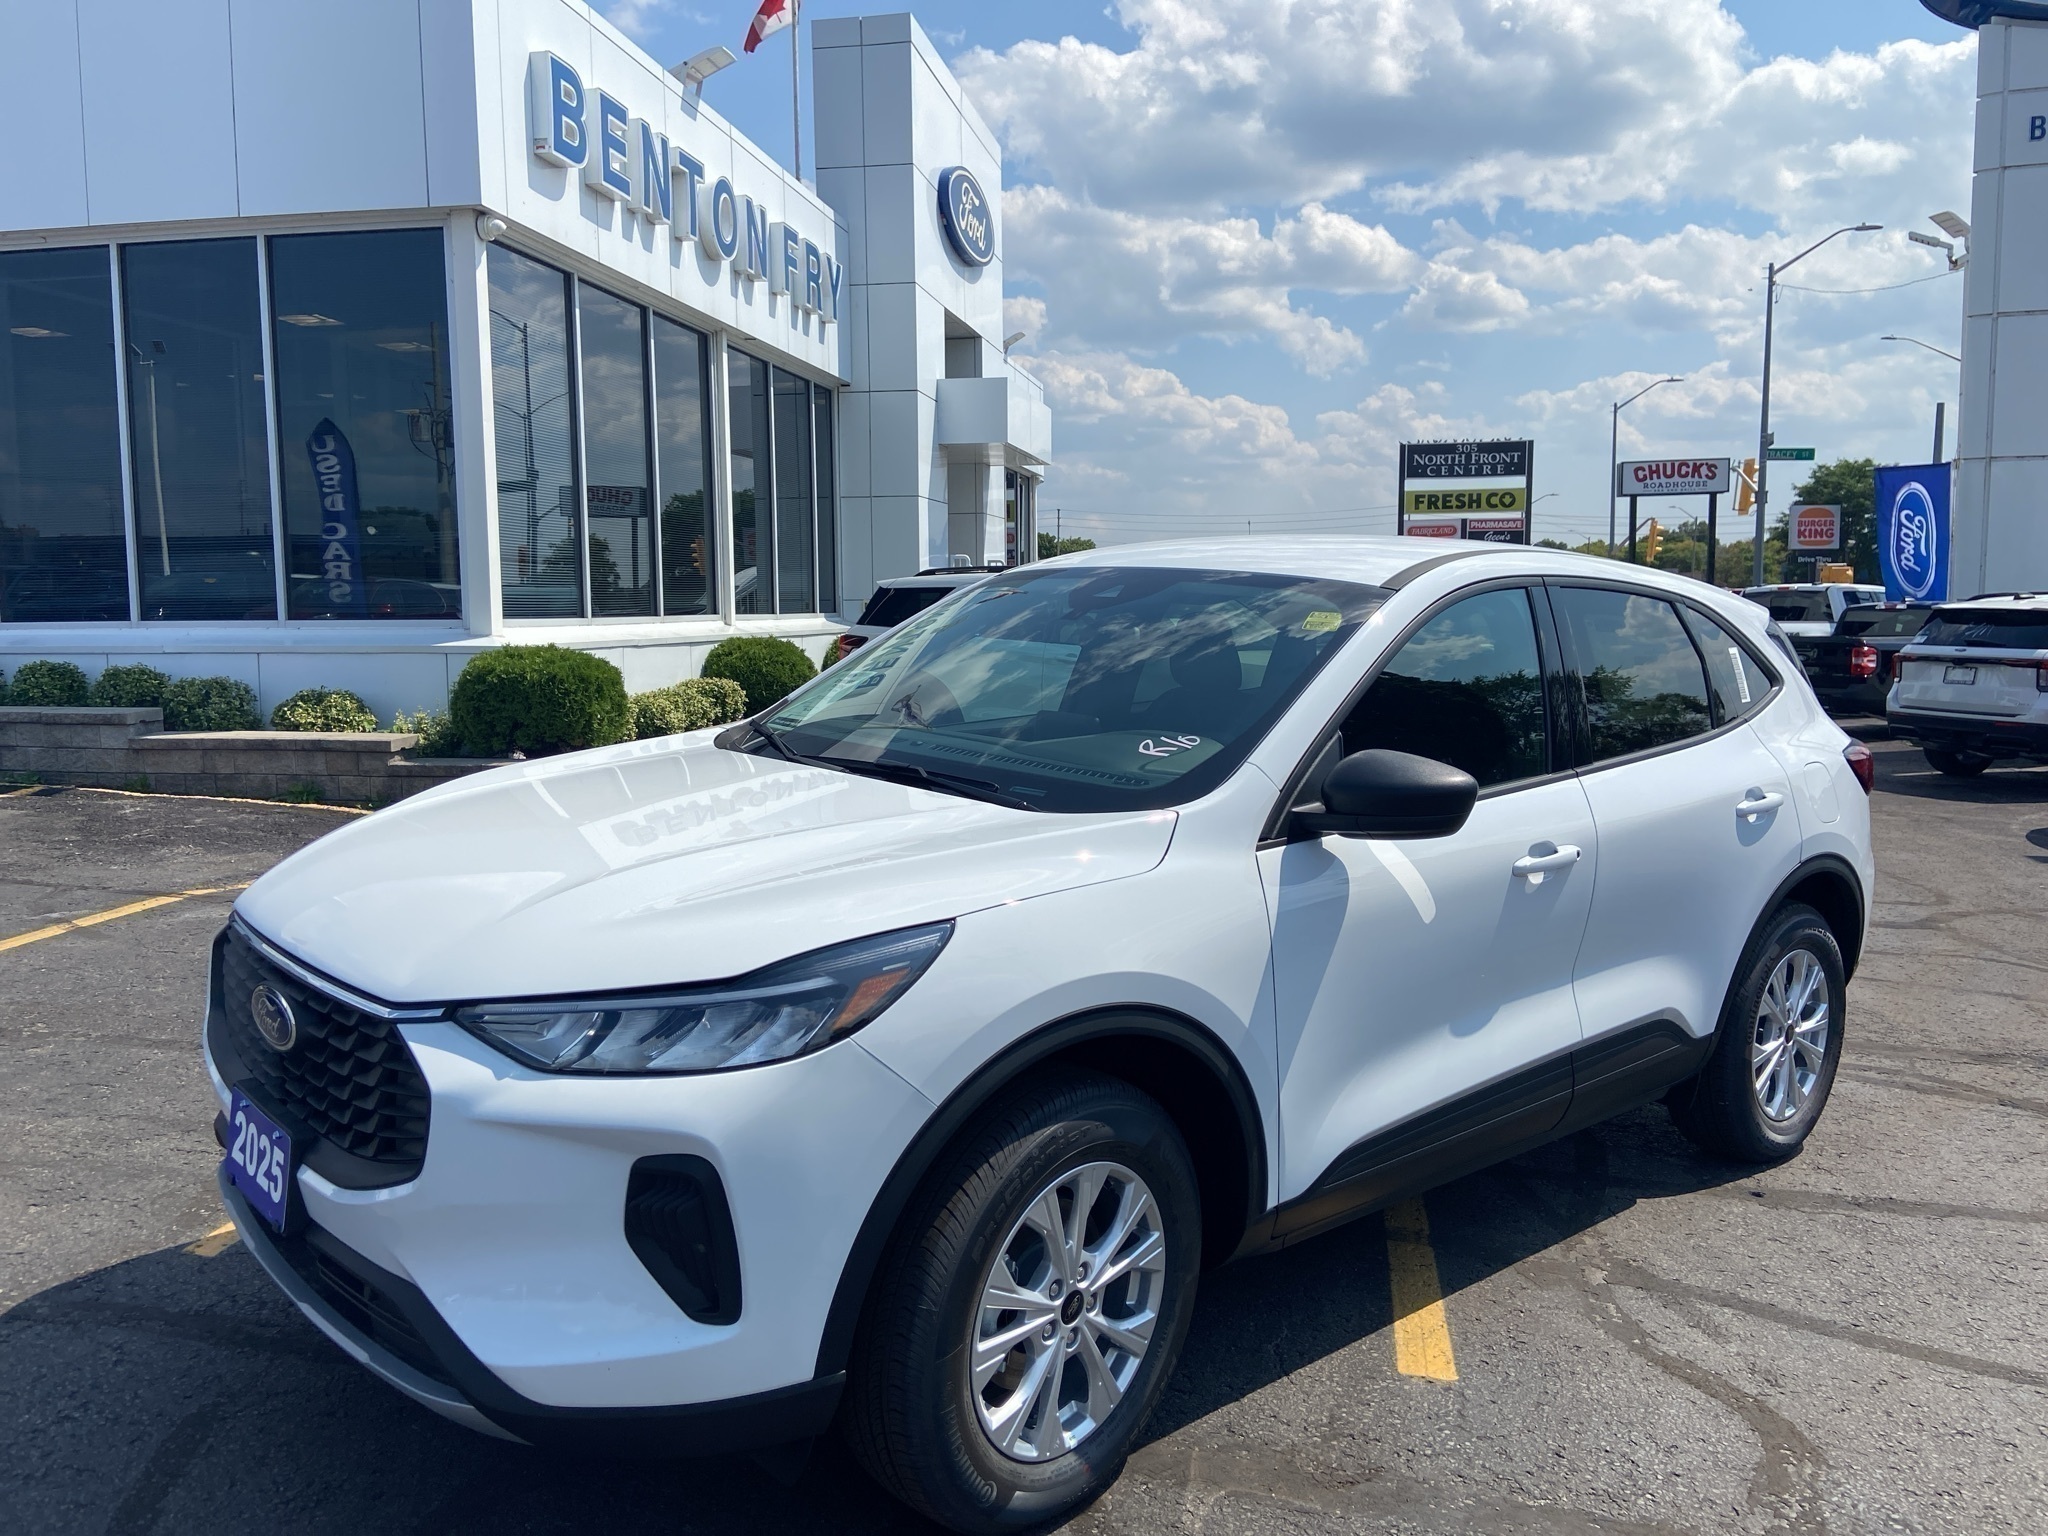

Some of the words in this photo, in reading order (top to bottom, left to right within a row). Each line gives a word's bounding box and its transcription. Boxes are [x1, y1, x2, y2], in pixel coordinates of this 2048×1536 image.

[530, 51, 768, 281] BENTON
[770, 221, 843, 325] FRY
[959, 182, 987, 251] Ford
[1456, 444, 1478, 454] 305
[1413, 453, 1467, 466] NORTH
[1470, 452, 1521, 464] FRONT
[1426, 464, 1505, 477] CENTRE
[1633, 461, 1718, 483] CHUCK'S
[1642, 480, 1708, 490] ROADHOUSE
[1470, 520, 1522, 529] PHARMASAVE
[1797, 519, 1835, 528] BURGER
[1797, 527, 1835, 539] KING
[1900, 509, 1927, 573] Ford
[257, 996, 282, 1040] Ford
[230, 1110, 285, 1204] 2025
